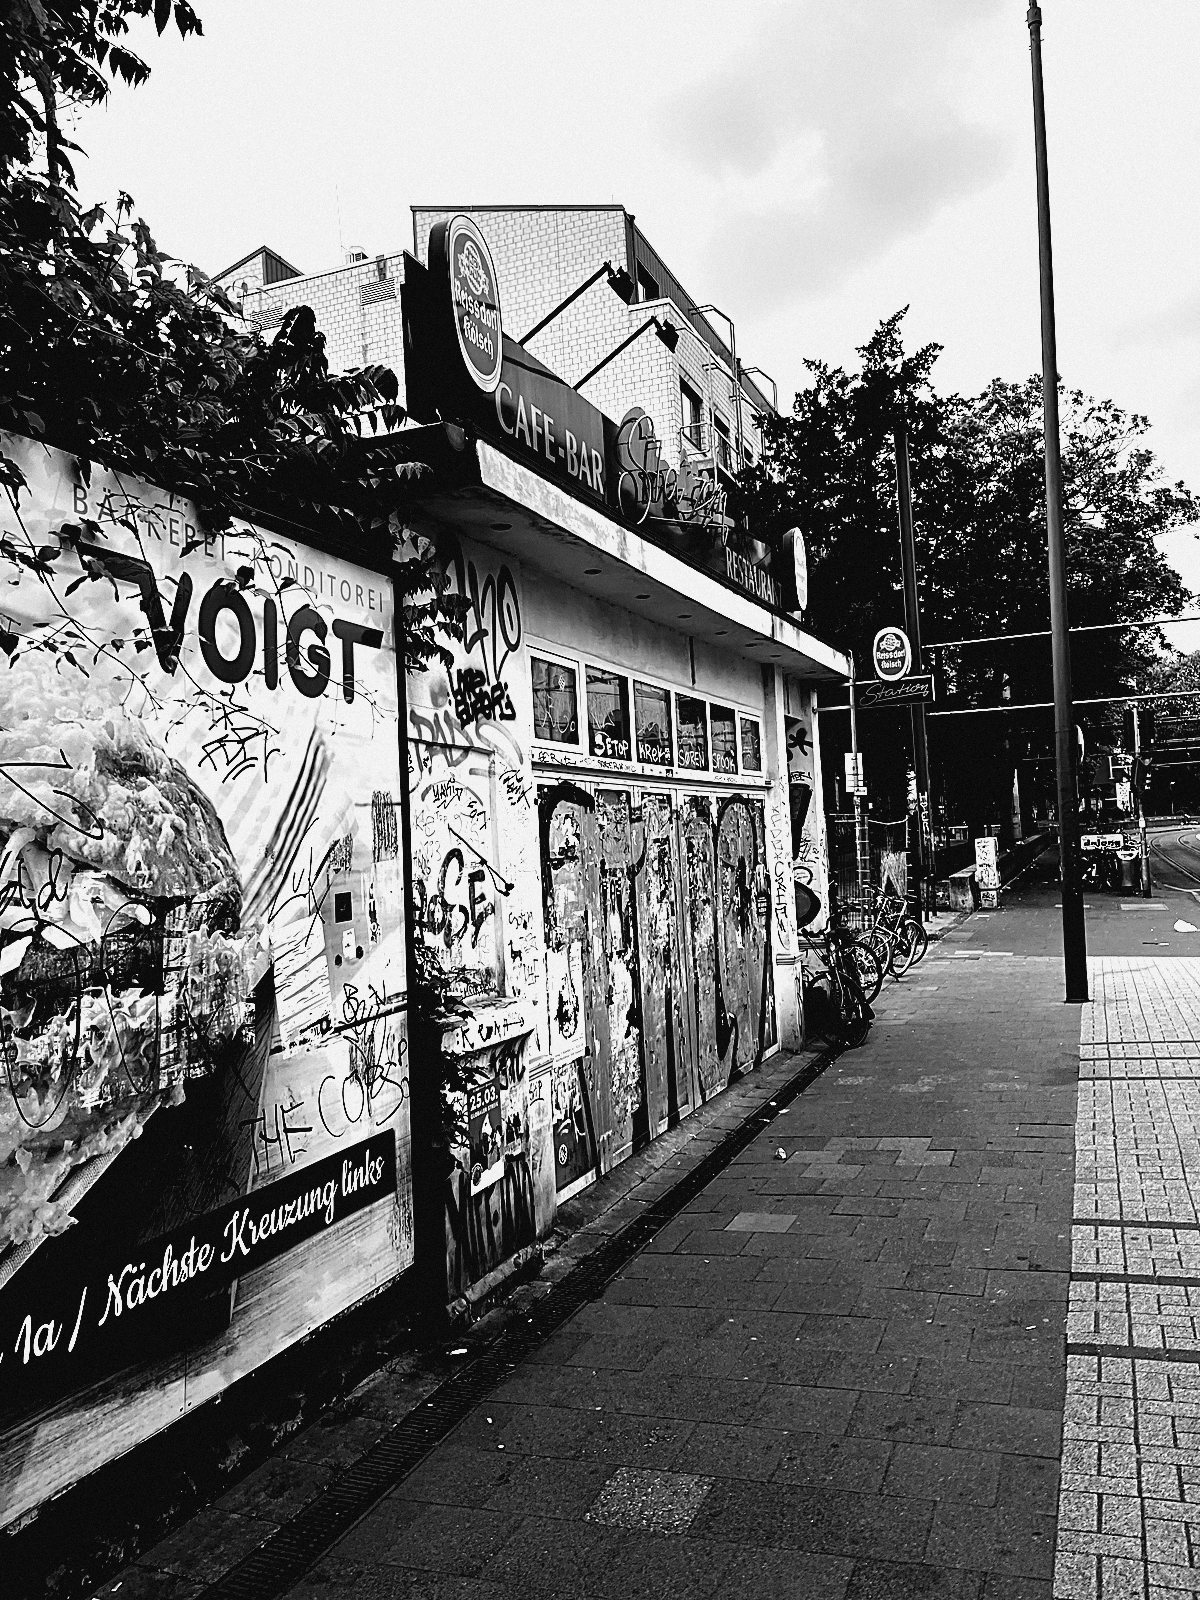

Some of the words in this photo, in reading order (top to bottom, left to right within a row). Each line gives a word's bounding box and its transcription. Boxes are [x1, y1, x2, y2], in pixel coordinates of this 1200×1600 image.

[495, 381, 605, 495] CAFE-BAR
[75, 541, 384, 704] VOIGT
[253, 547, 383, 613] KONDITOREI
[860, 683, 930, 706] Station
[470, 1085, 499, 1112] 25.03.
[14, 1315, 63, 1365] 1a
[68, 1286, 88, 1352] /
[98, 1236, 216, 1327] Nächste
[220, 1178, 339, 1264] Kreuzung
[341, 1149, 385, 1197] links
